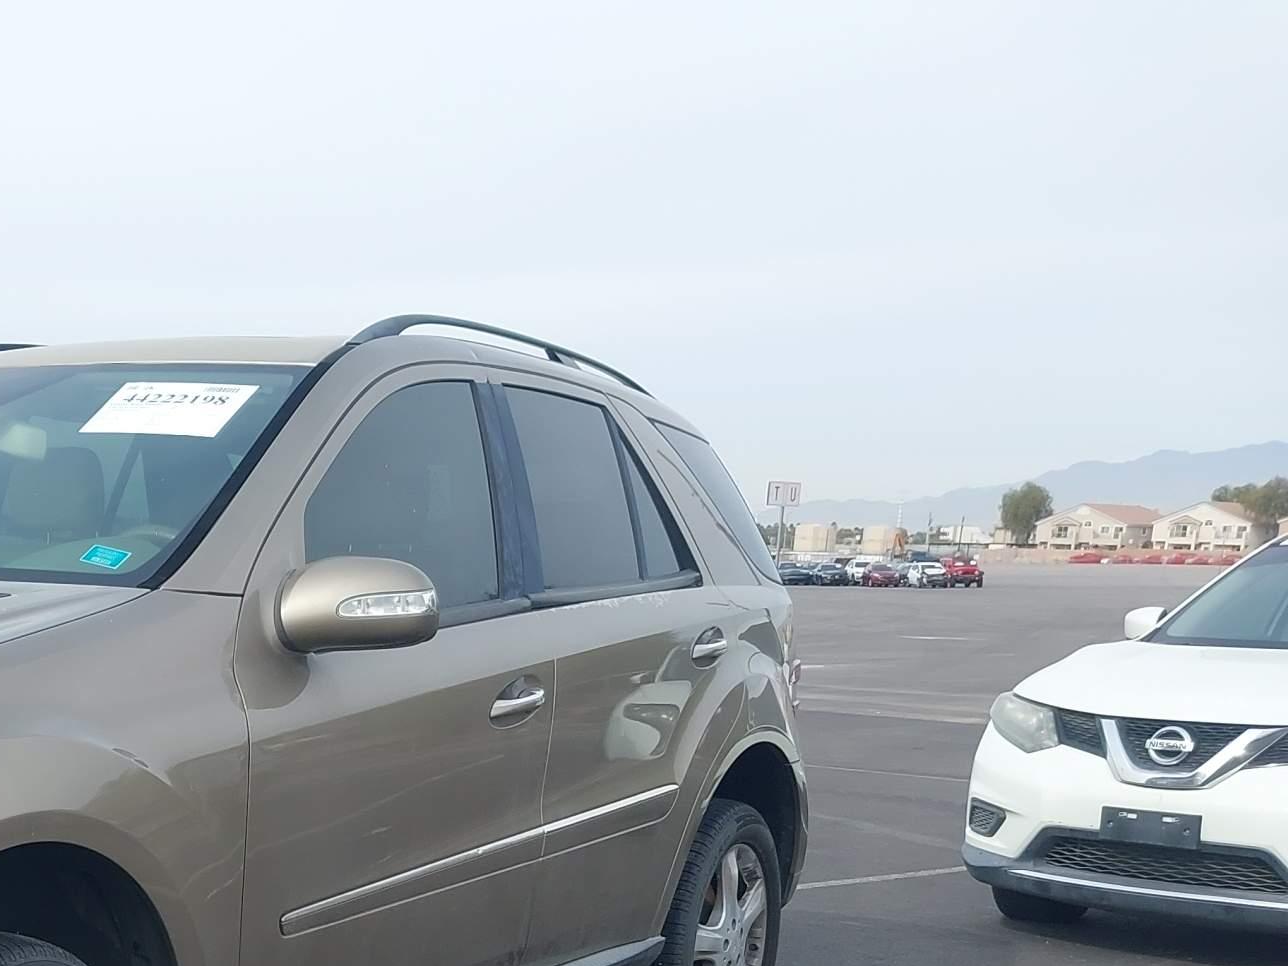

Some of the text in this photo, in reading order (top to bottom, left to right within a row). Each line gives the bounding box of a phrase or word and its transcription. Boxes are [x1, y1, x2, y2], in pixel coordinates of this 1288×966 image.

[123, 393, 230, 406] 44222198
[775, 486, 781, 501] T
[790, 487, 797, 502] U
[1149, 740, 1187, 750] NISSAN
